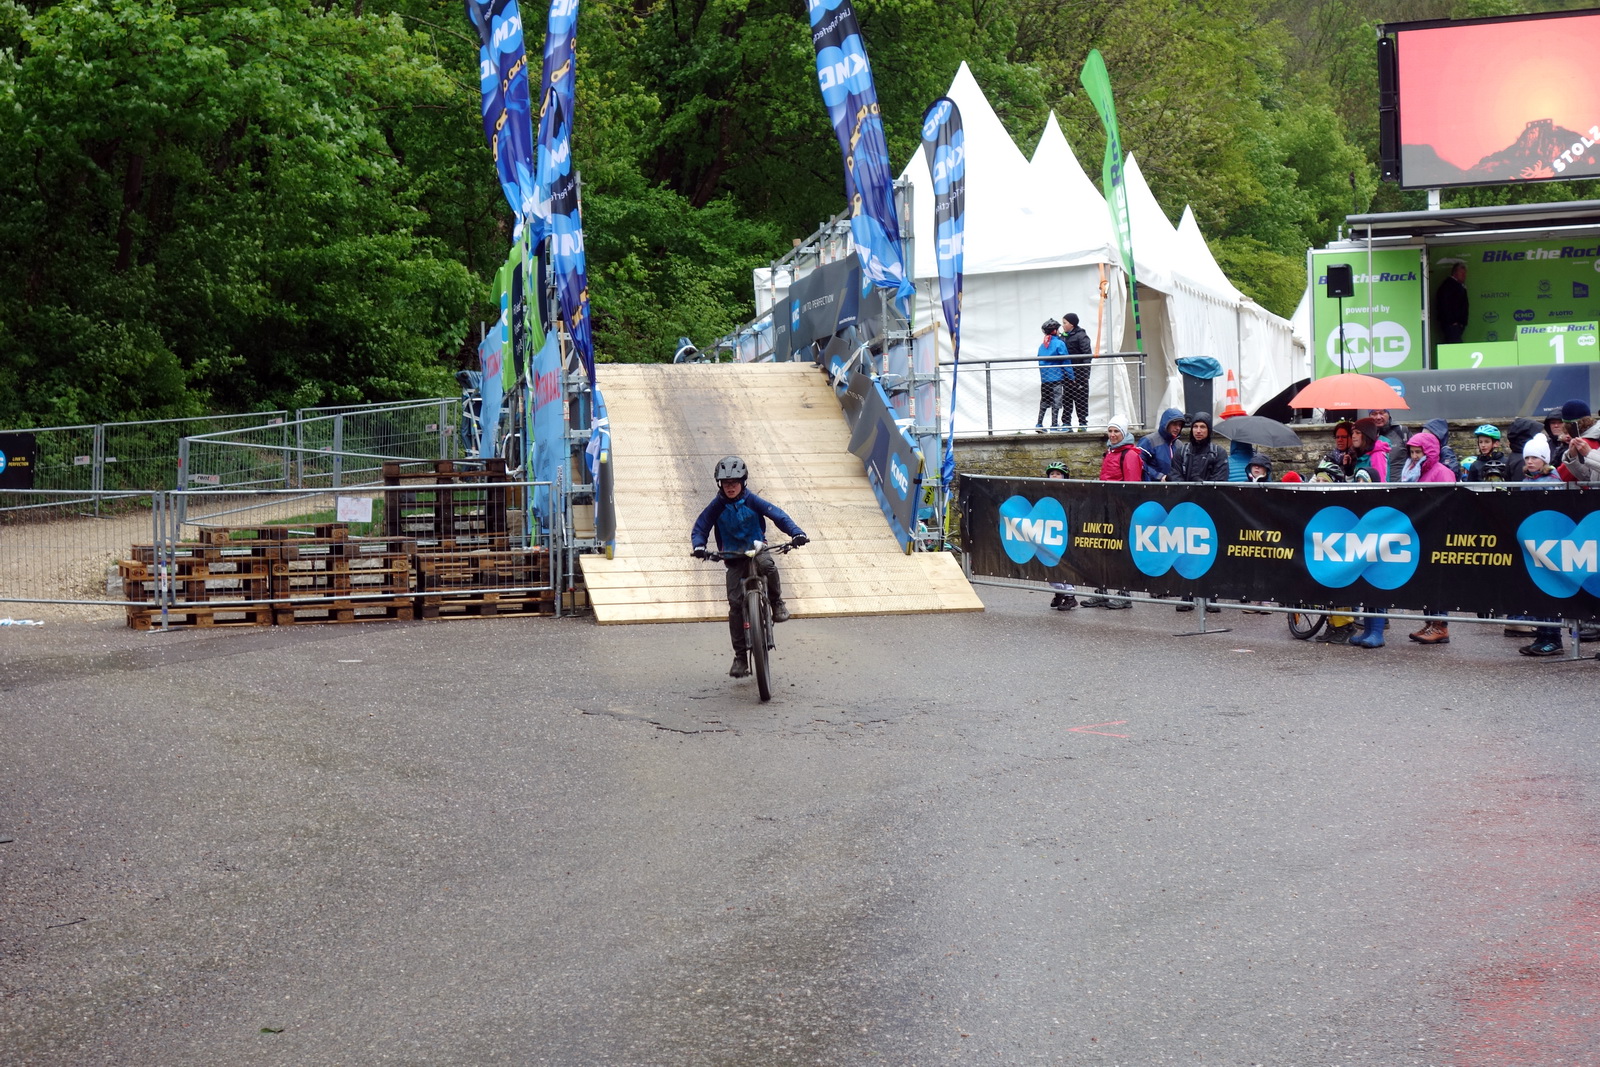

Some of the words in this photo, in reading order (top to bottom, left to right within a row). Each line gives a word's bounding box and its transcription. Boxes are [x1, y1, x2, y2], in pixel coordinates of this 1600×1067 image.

[1482, 245, 1600, 263] BiketheRoc
[1318, 271, 1417, 285] BtheRock
[1380, 304, 1390, 314] by
[1334, 335, 1405, 355] KMC
[1549, 334, 1565, 364] 1
[1470, 351, 1484, 369] 2
[1421, 384, 1443, 394] LINK
[1445, 383, 1457, 393] TO
[1459, 381, 1513, 391] PERFECTION
[1004, 516, 1064, 546] KMC
[1083, 523, 1102, 534] LINK
[1102, 523, 1114, 534] TO
[1239, 529, 1263, 541] LINK
[1265, 530, 1281, 542] TO
[1074, 536, 1124, 550] PERFECTION
[1135, 524, 1211, 556] KMC
[1312, 532, 1412, 563] KMC
[1446, 534, 1477, 548] LINK
[1479, 534, 1497, 548] TO
[1227, 545, 1294, 560] PERFECTION
[1431, 551, 1513, 566] PERFECTION
